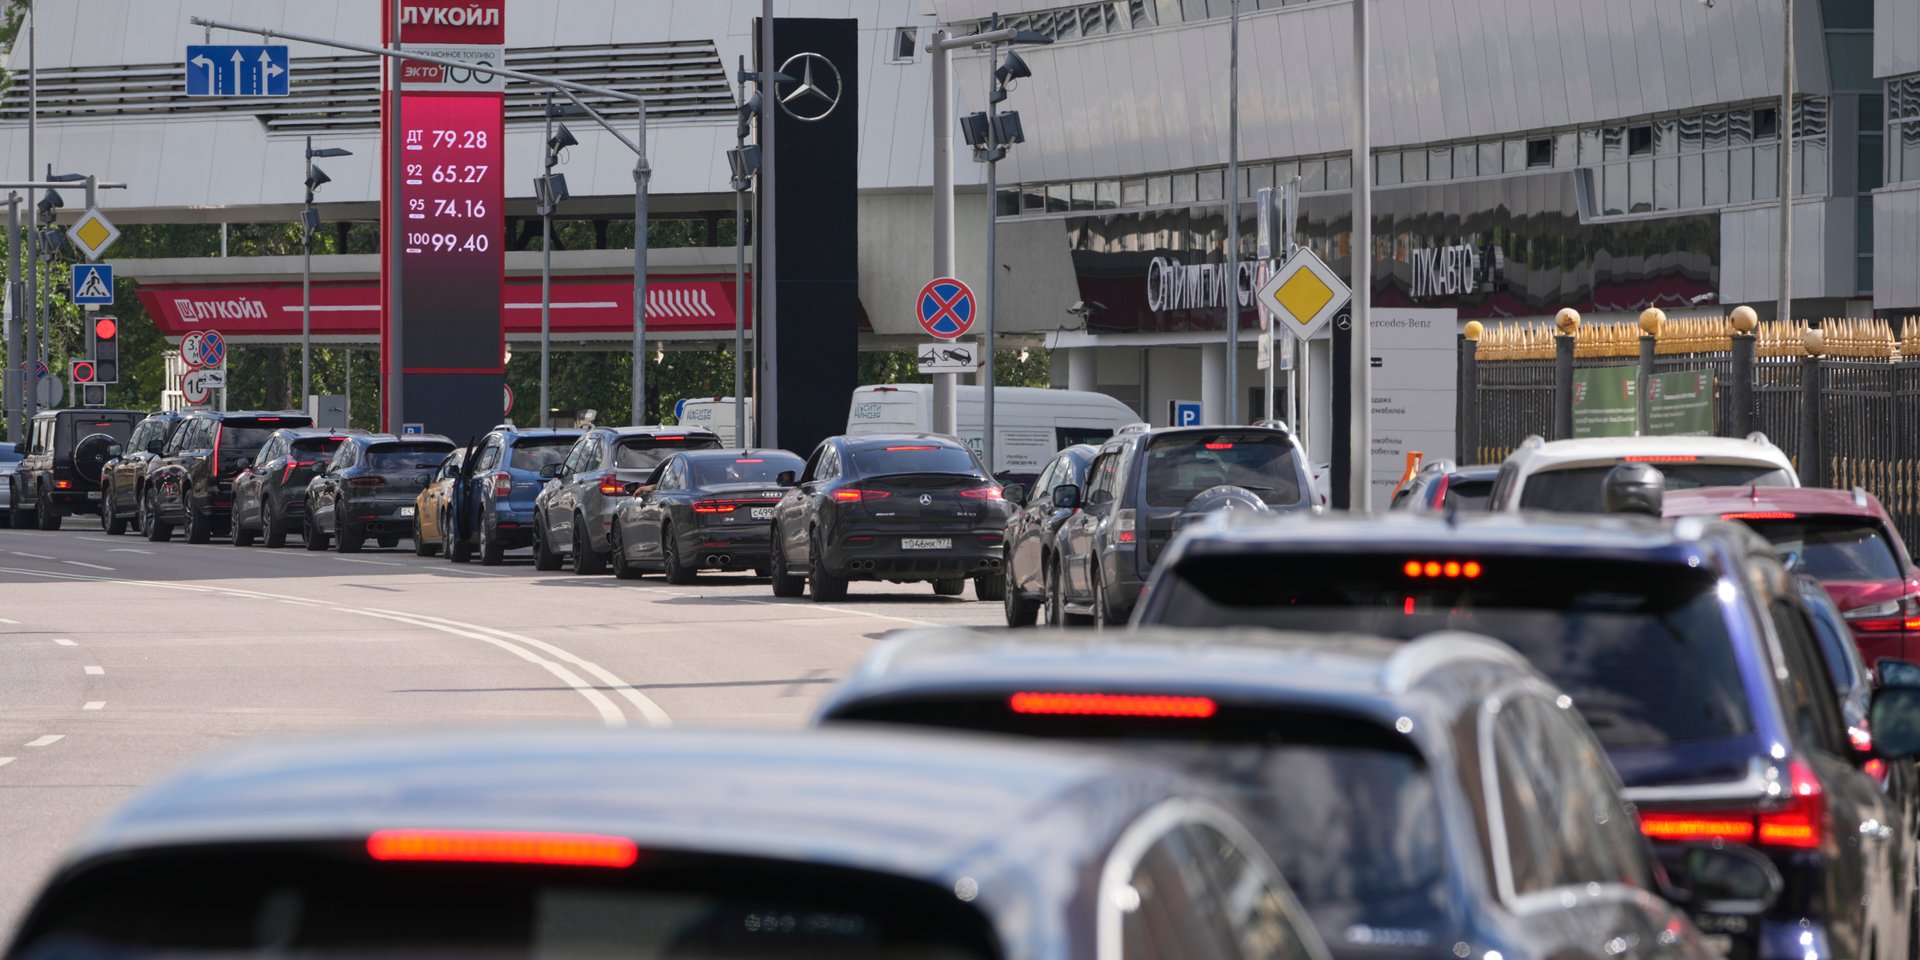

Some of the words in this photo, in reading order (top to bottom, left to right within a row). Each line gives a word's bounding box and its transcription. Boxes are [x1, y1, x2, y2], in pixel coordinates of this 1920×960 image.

[401, 3, 499, 26] ЛУКОЙЛ
[462, 51, 495, 59] ТОПЛИВО
[405, 66, 438, 77] ЭКТО
[440, 60, 495, 84] 100
[406, 130, 423, 144] ДТ
[432, 130, 487, 149] 79.28
[406, 164, 422, 176] 92
[432, 165, 488, 183] 65.27
[409, 199, 425, 210] 95
[434, 199, 485, 218] 74.16
[408, 233, 430, 245] 100
[431, 233, 488, 252] 99.40
[1409, 243, 1474, 297] ЛУКАВТО
[194, 297, 267, 318] ЛУКОЙЛ
[1370, 318, 1432, 328] ercedes-Benz
[1183, 410, 1195, 426] P
